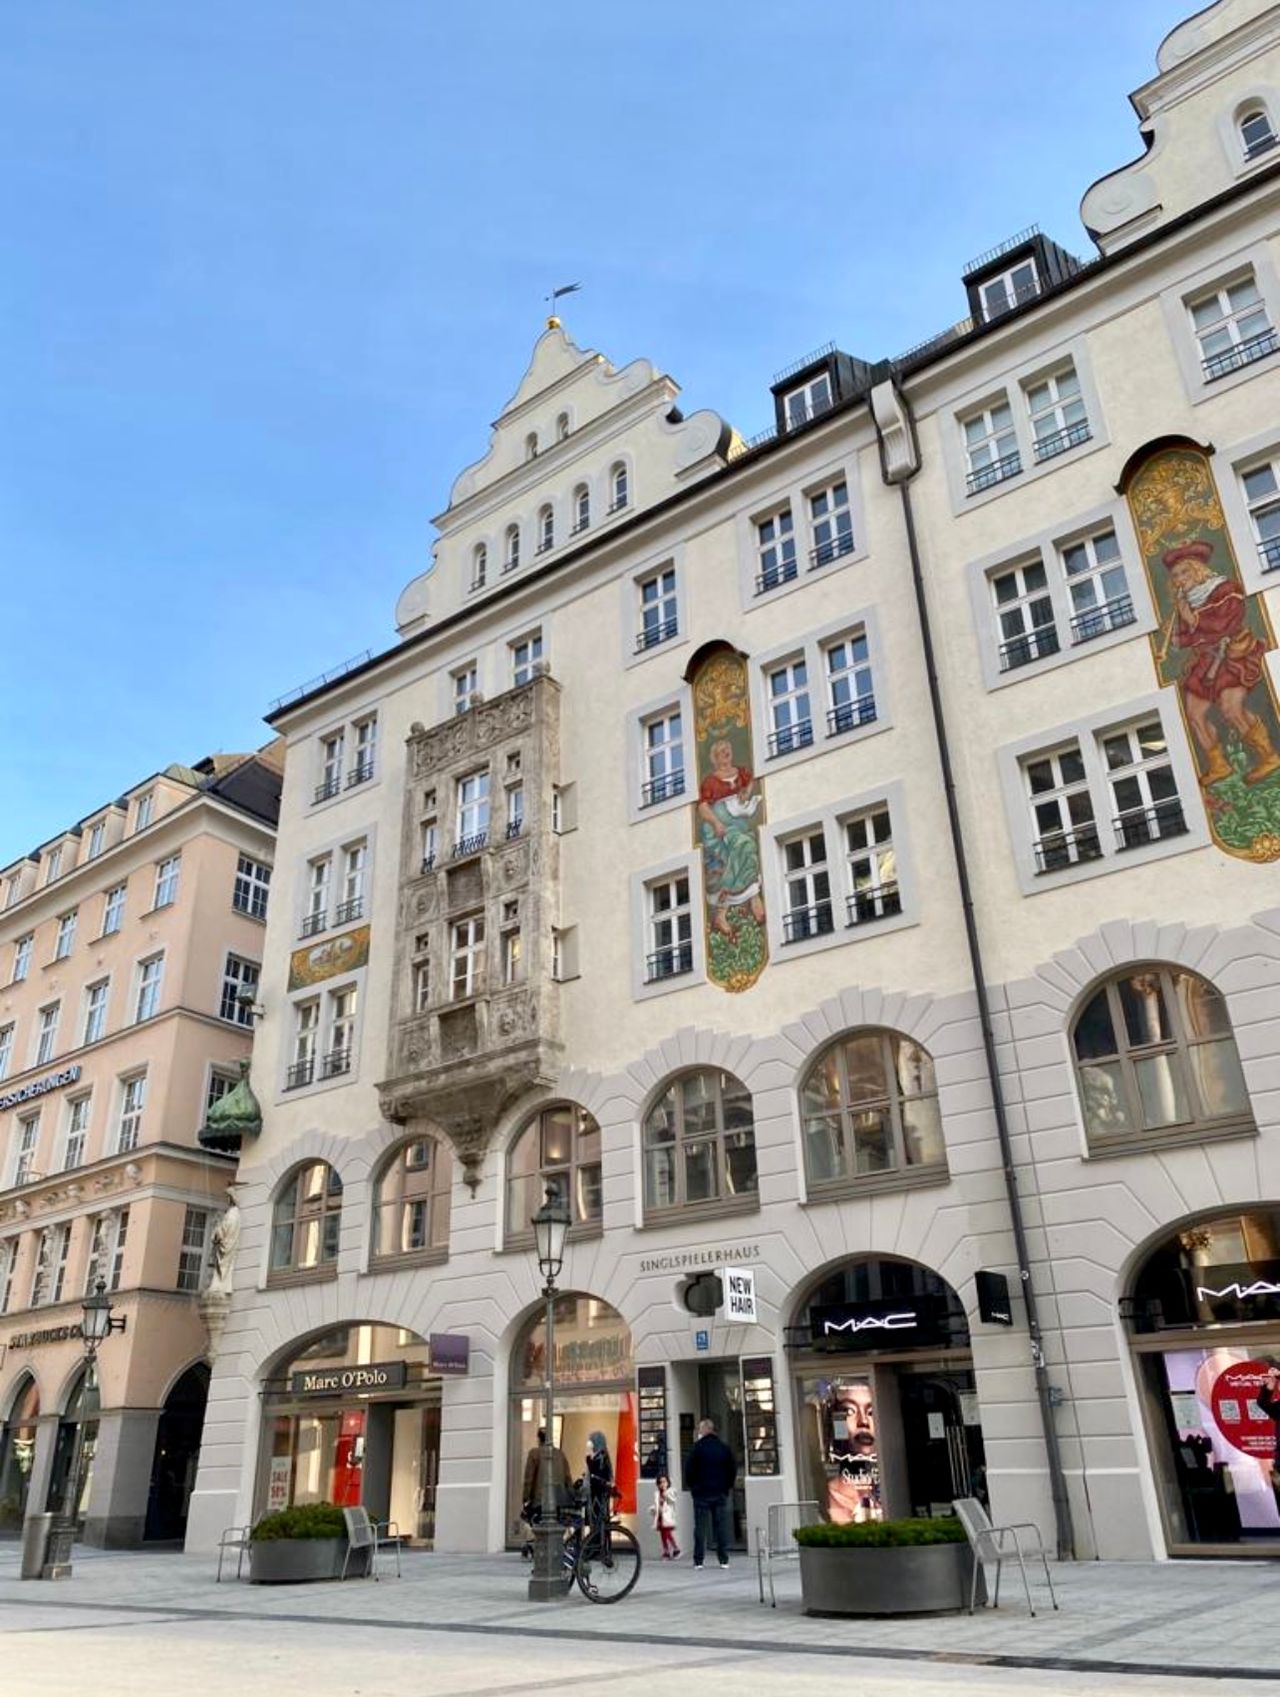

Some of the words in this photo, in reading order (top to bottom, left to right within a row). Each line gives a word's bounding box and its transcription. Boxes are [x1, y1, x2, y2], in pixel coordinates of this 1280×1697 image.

[640, 1245, 760, 1272] SINGLSPIELERHAUS
[729, 1275, 752, 1295] NEW
[1197, 1281, 1280, 1302] MA
[730, 1296, 754, 1315] HAIR
[824, 1312, 917, 1335] MAC
[304, 1375, 339, 1391] Marc
[342, 1369, 388, 1387] O'Polo
